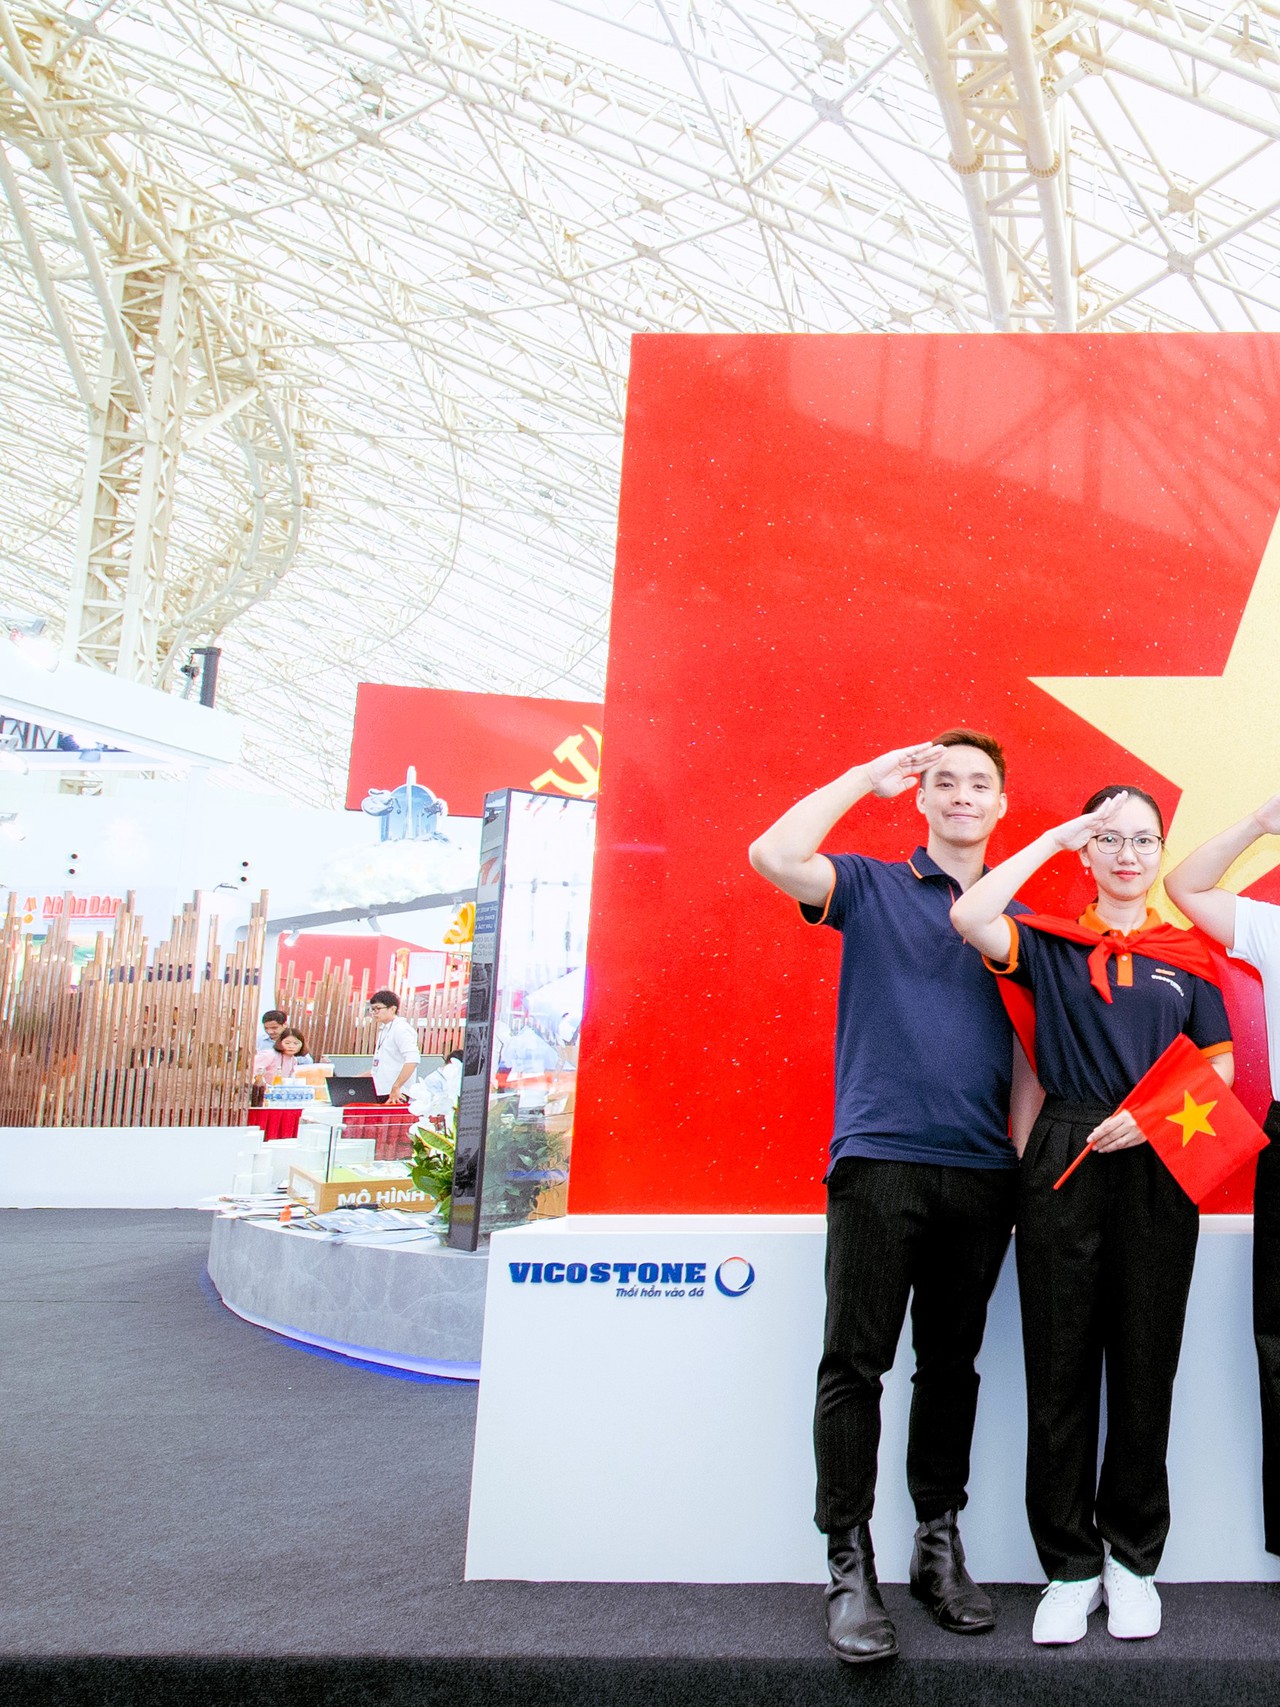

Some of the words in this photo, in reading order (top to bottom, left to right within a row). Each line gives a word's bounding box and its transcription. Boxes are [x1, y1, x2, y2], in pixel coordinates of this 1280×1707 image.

[338, 1189, 372, 1206] MÔ
[377, 1187, 426, 1204] HÌNH
[509, 1262, 706, 1284] VICOSTONE
[688, 1287, 705, 1298] đá
